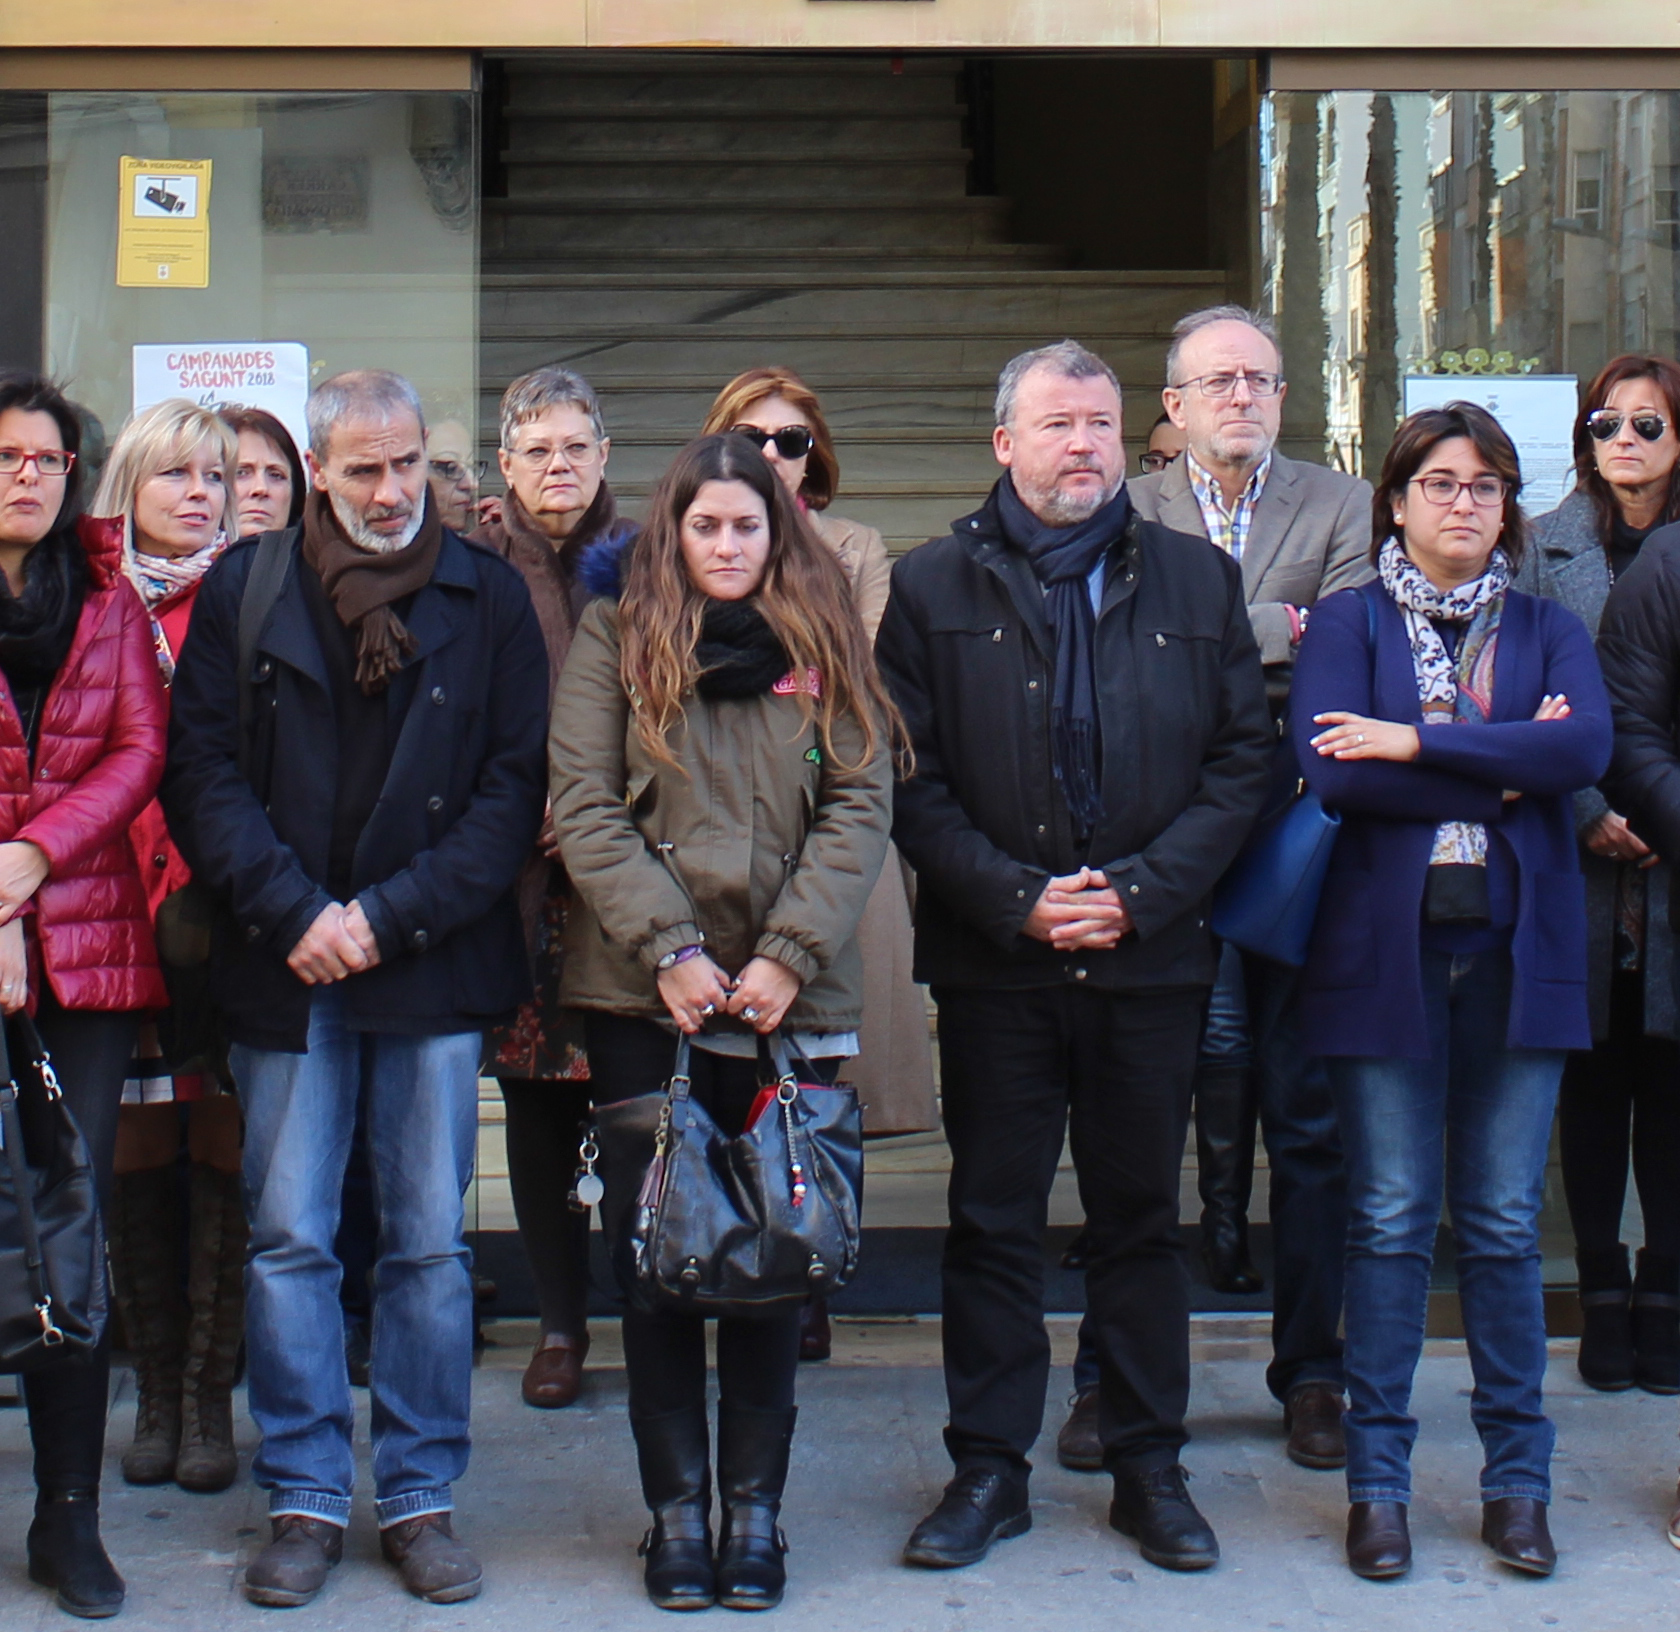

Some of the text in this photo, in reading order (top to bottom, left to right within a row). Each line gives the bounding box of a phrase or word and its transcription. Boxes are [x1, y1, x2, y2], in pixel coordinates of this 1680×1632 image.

[166, 351, 275, 371] CAMPANADES
[179, 370, 275, 388] SAGUNT 2018
